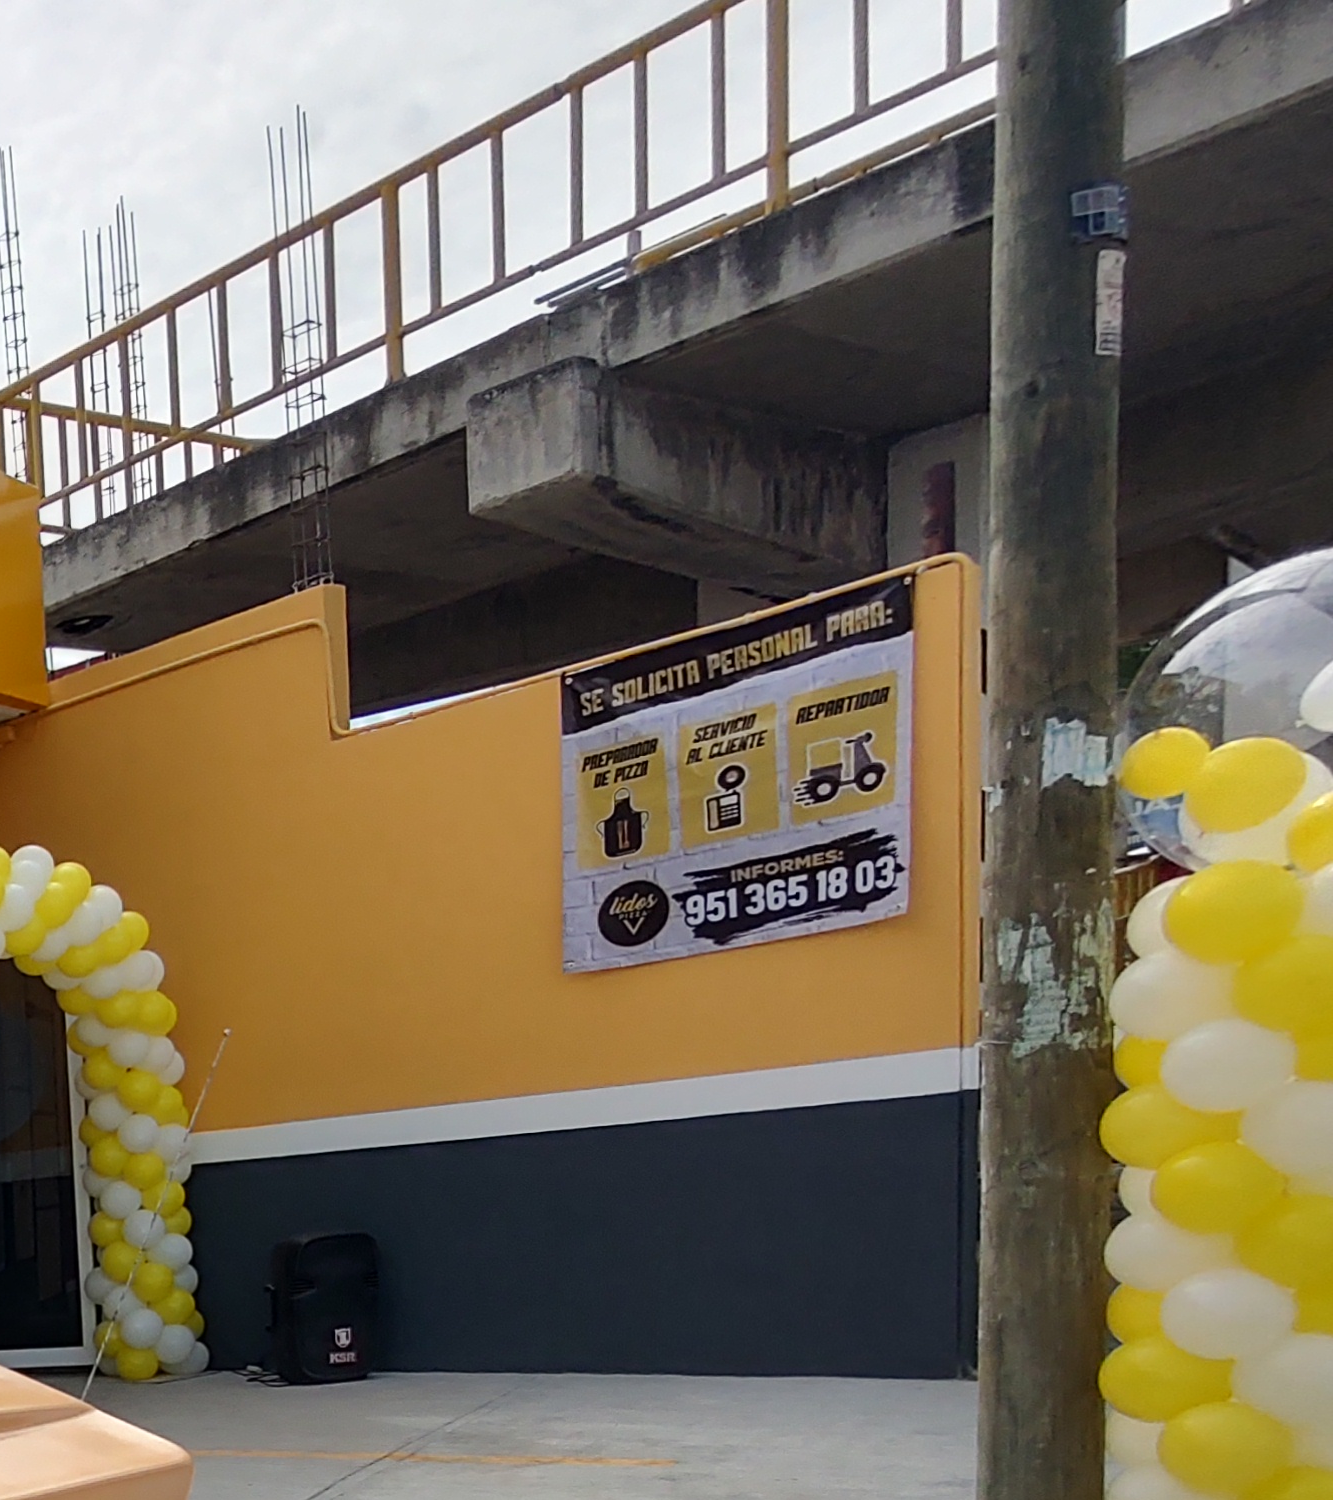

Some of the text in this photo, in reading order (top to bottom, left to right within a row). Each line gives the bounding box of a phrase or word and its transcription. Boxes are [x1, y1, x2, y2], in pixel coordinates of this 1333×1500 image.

[579, 600, 895, 717] SE SOLICITA PERSONAL PARA:
[795, 686, 891, 726] REPARTIDOR
[693, 712, 758, 744] SERVICIO
[581, 737, 659, 773] PREPARADOR
[686, 730, 769, 766] AL CLIENTE
[593, 760, 649, 789] DE PIZZA
[730, 849, 845, 884] INFORMES:
[609, 893, 659, 917] lidos
[685, 854, 897, 927] 951 365 18 03
